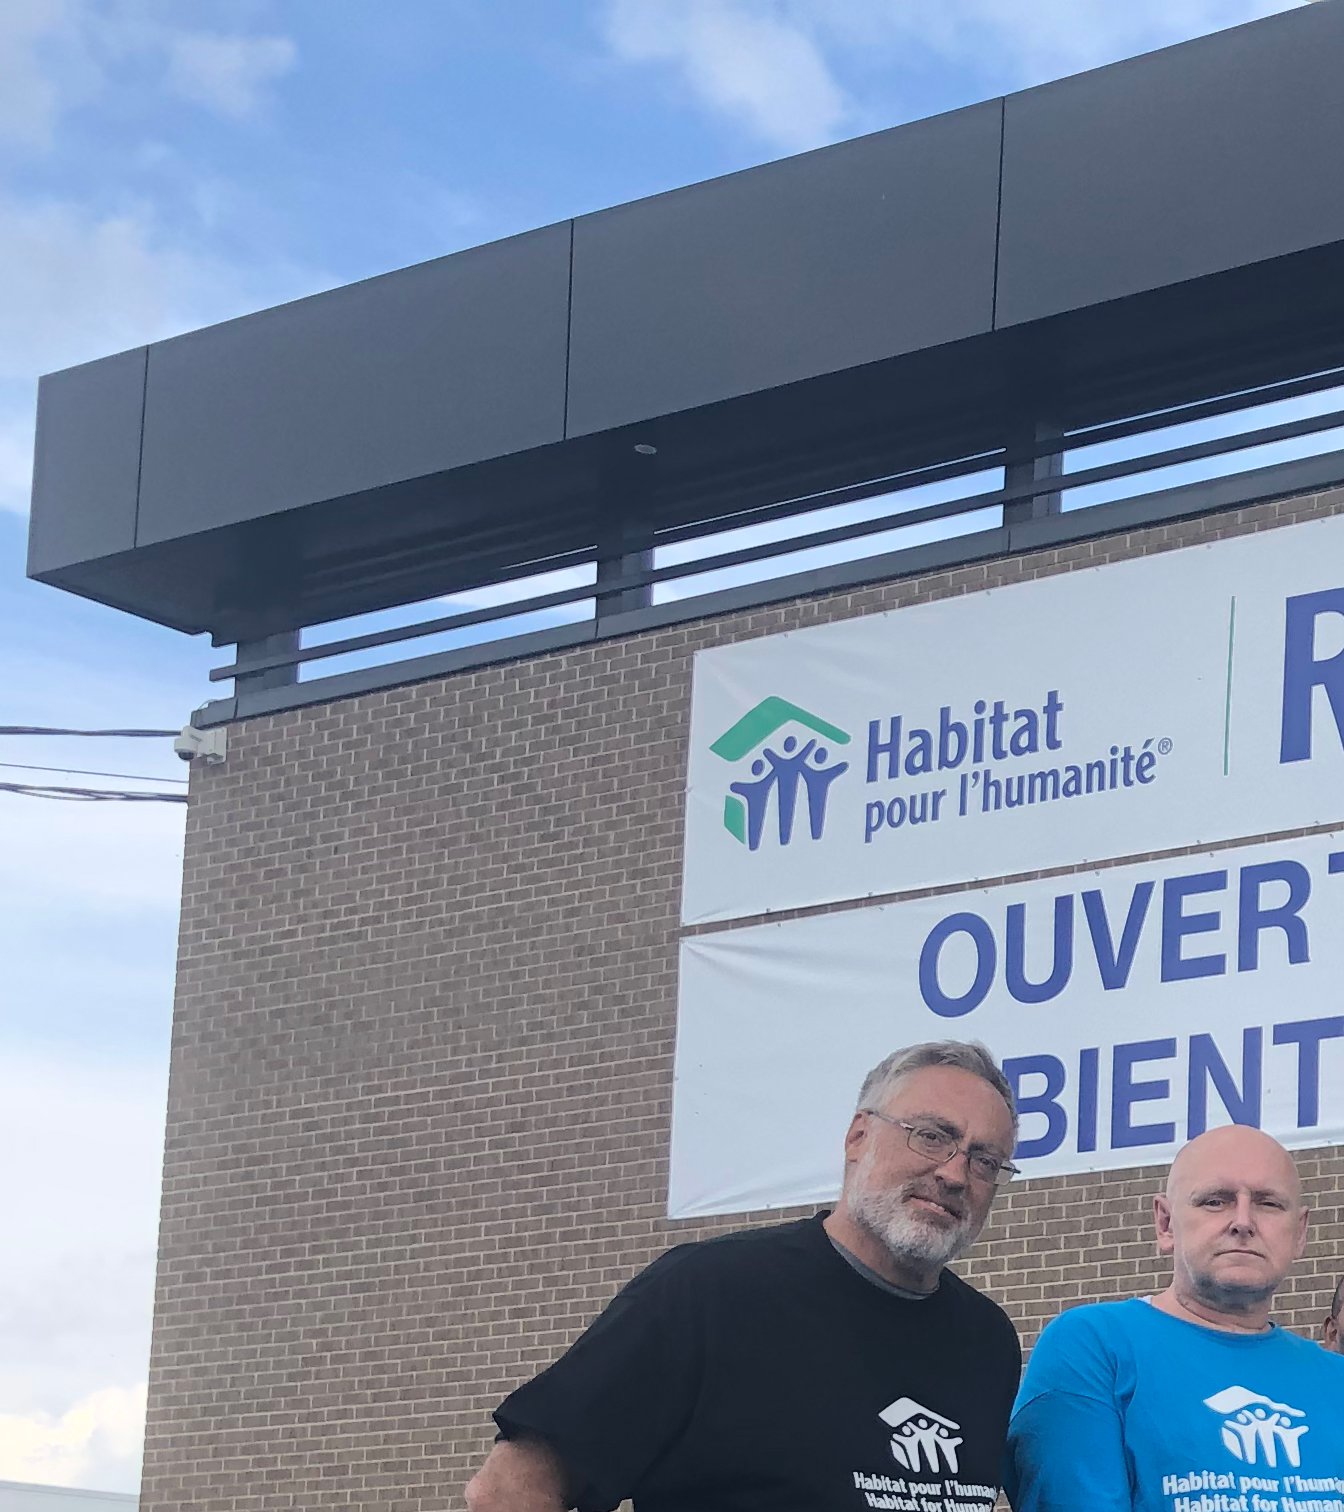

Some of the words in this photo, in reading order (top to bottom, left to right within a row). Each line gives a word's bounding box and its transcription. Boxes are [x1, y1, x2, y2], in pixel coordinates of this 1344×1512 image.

[865, 689, 1065, 783] Habitat
[863, 785, 948, 844] pour
[853, 1471, 907, 1494] Habitat
[908, 1481, 942, 1497] pour
[1162, 1470, 1237, 1496] Habitat
[1239, 1475, 1280, 1494] pour
[865, 1492, 920, 1512] Habitat
[1251, 1494, 1279, 1512] for
